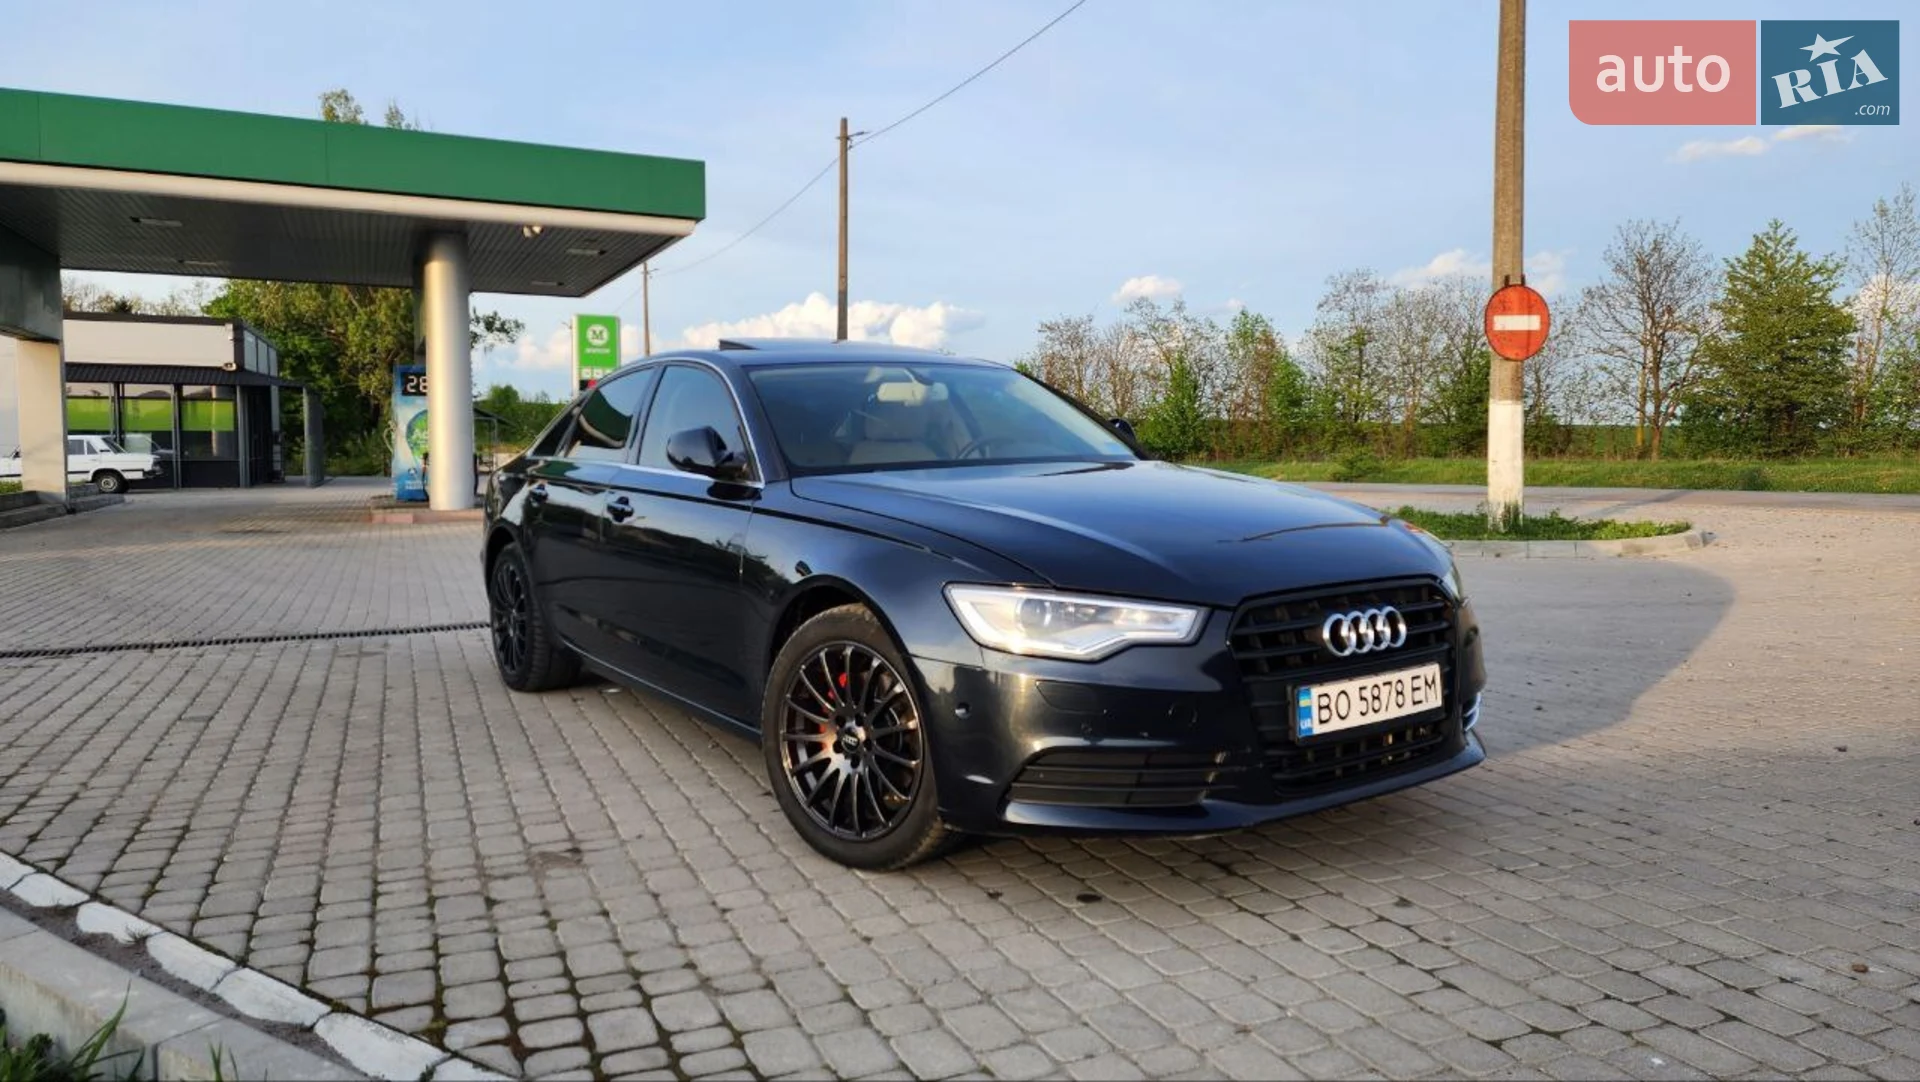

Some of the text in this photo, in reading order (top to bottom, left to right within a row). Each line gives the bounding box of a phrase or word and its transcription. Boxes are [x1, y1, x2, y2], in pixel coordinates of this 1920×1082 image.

[1317, 671, 1438, 725] BO 5878 EM
